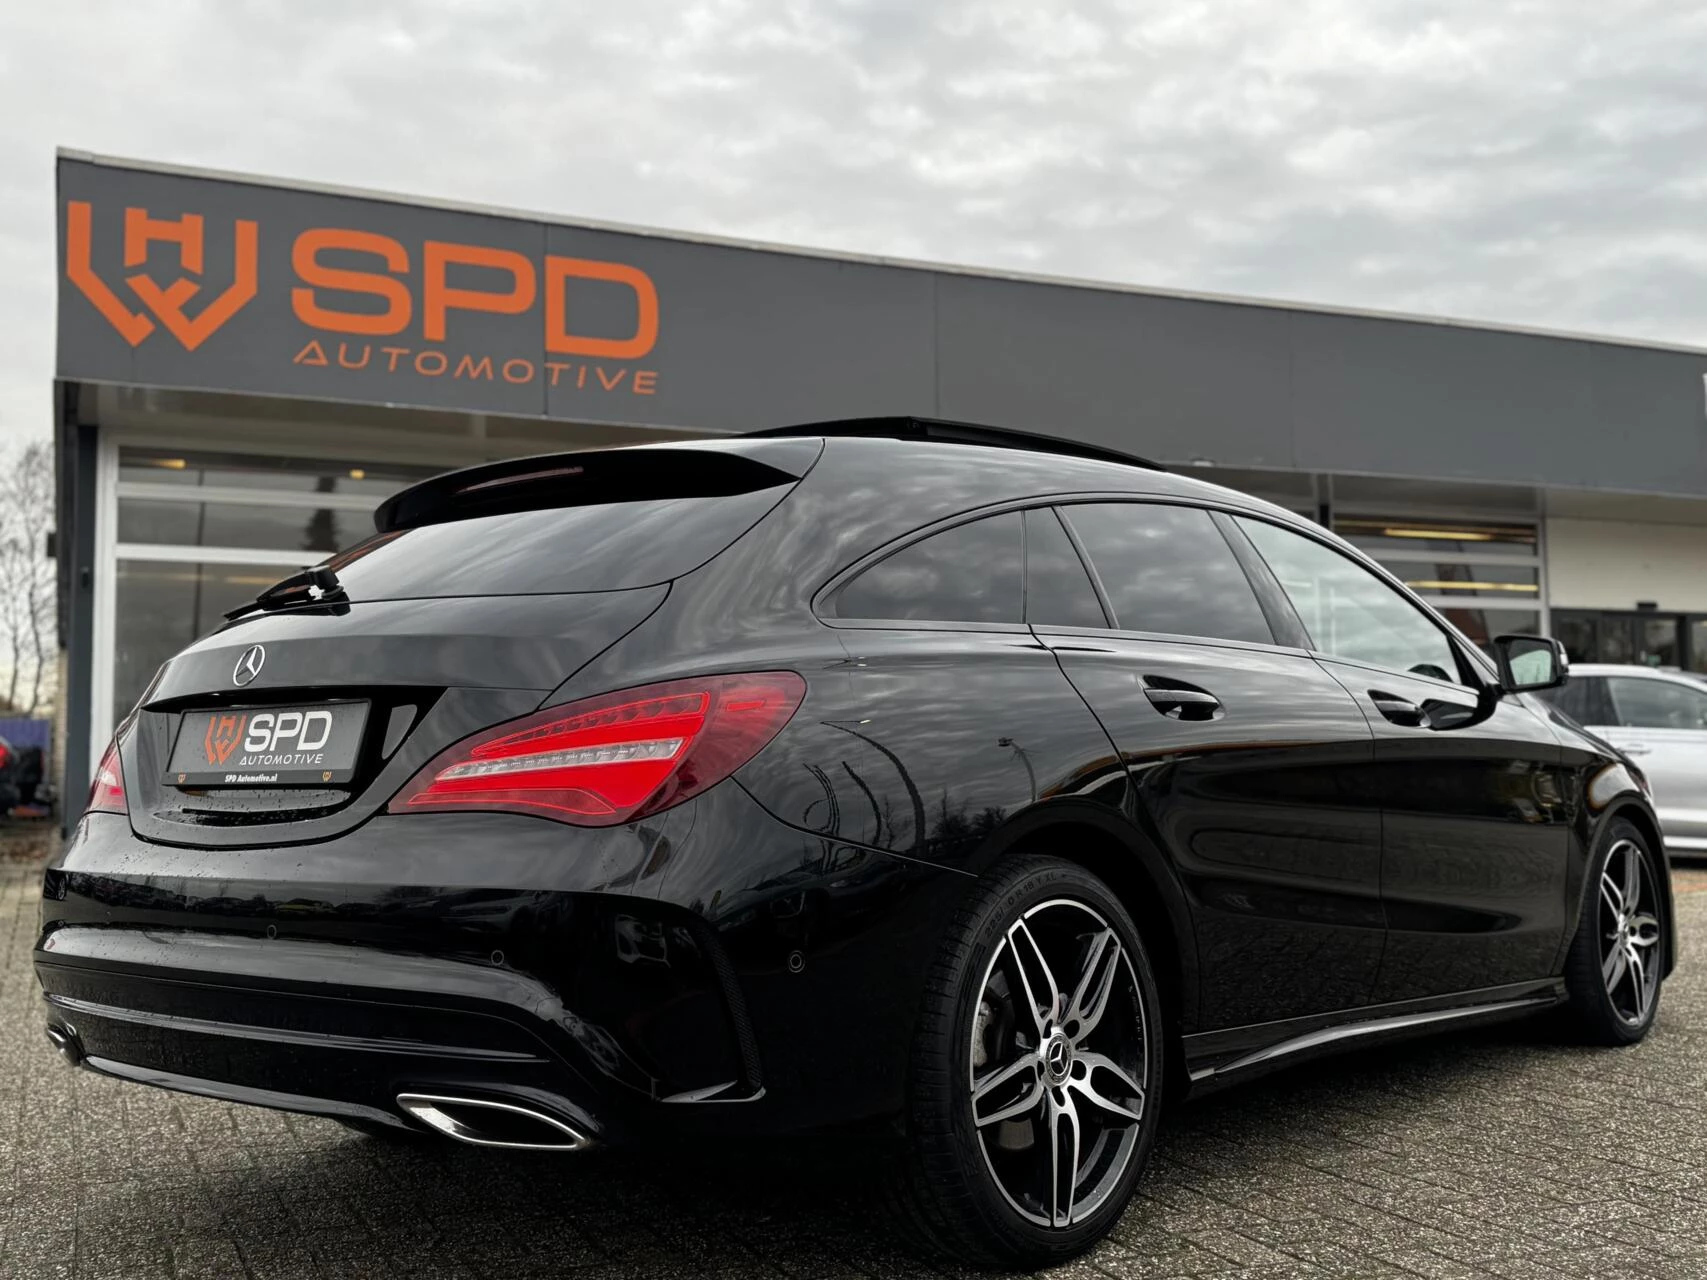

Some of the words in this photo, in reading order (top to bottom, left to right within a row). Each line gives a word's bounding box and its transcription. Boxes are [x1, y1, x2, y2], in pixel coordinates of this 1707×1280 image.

[291, 227, 659, 360] SPD
[293, 340, 659, 394] AUTOMOTIVE
[244, 711, 333, 752] SPD
[225, 774, 237, 783] SPD
[237, 773, 278, 783] Automotive.nl
[239, 753, 324, 766] AUTOMOTIVE
